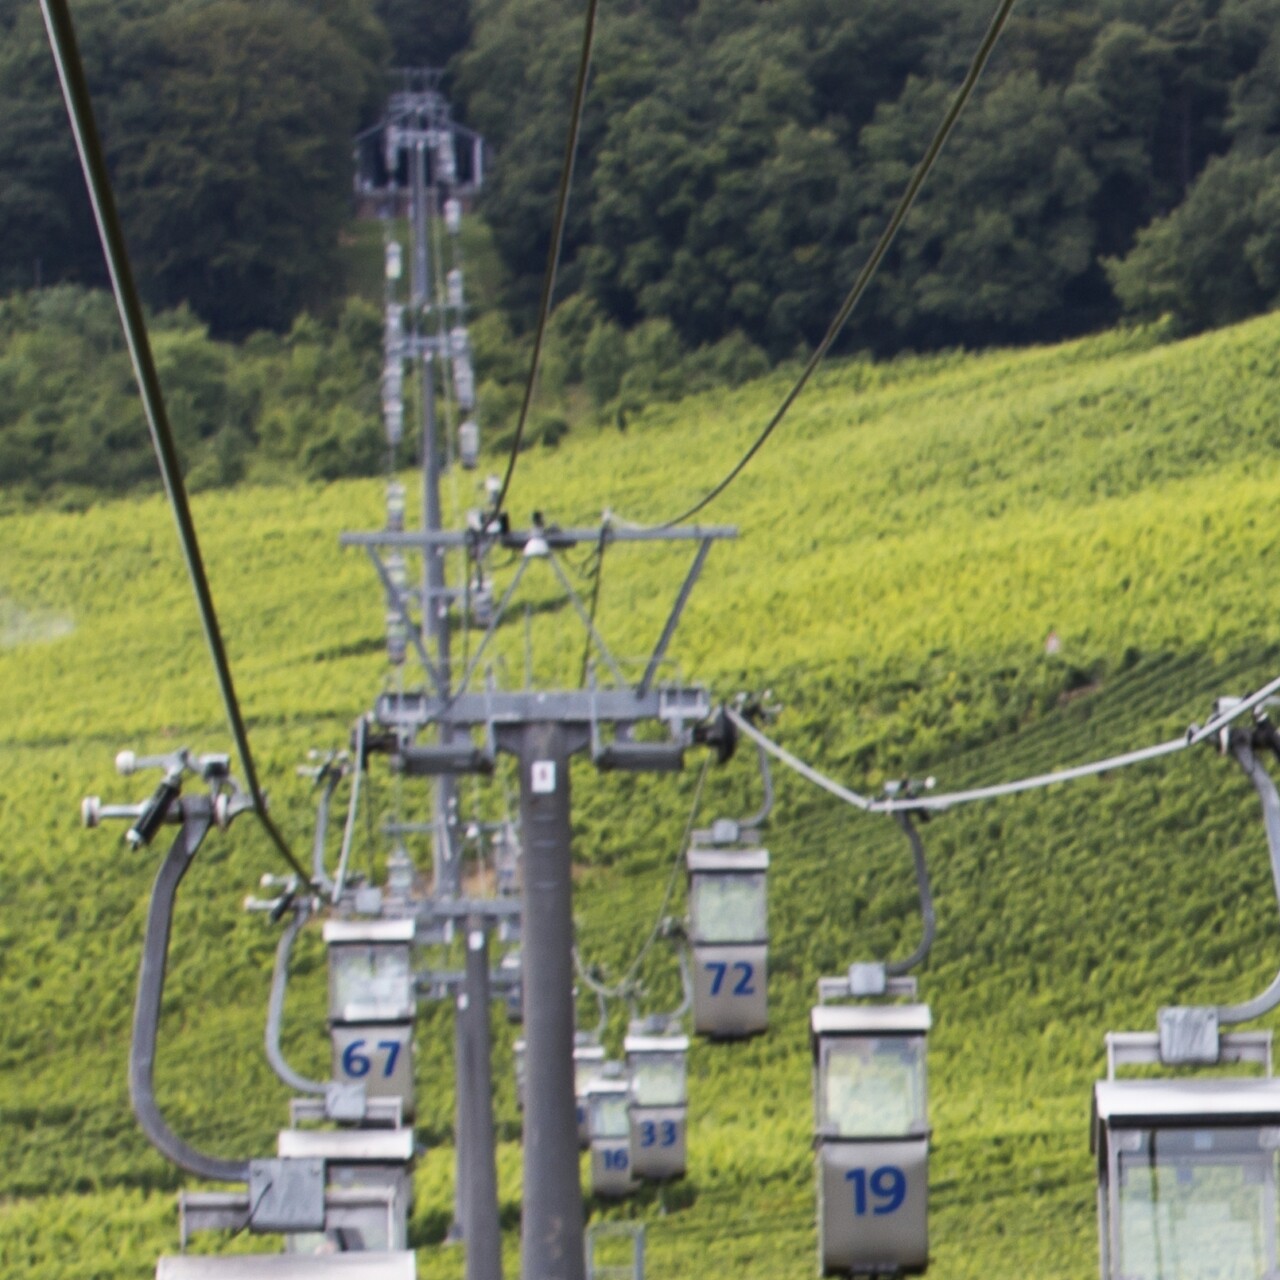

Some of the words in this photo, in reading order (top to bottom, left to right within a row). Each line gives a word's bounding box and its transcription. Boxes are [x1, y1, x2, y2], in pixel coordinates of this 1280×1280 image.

[705, 960, 755, 996] 72
[342, 1039, 401, 1078] 67
[641, 1119, 677, 1148] 33
[844, 1164, 908, 1216] 19
